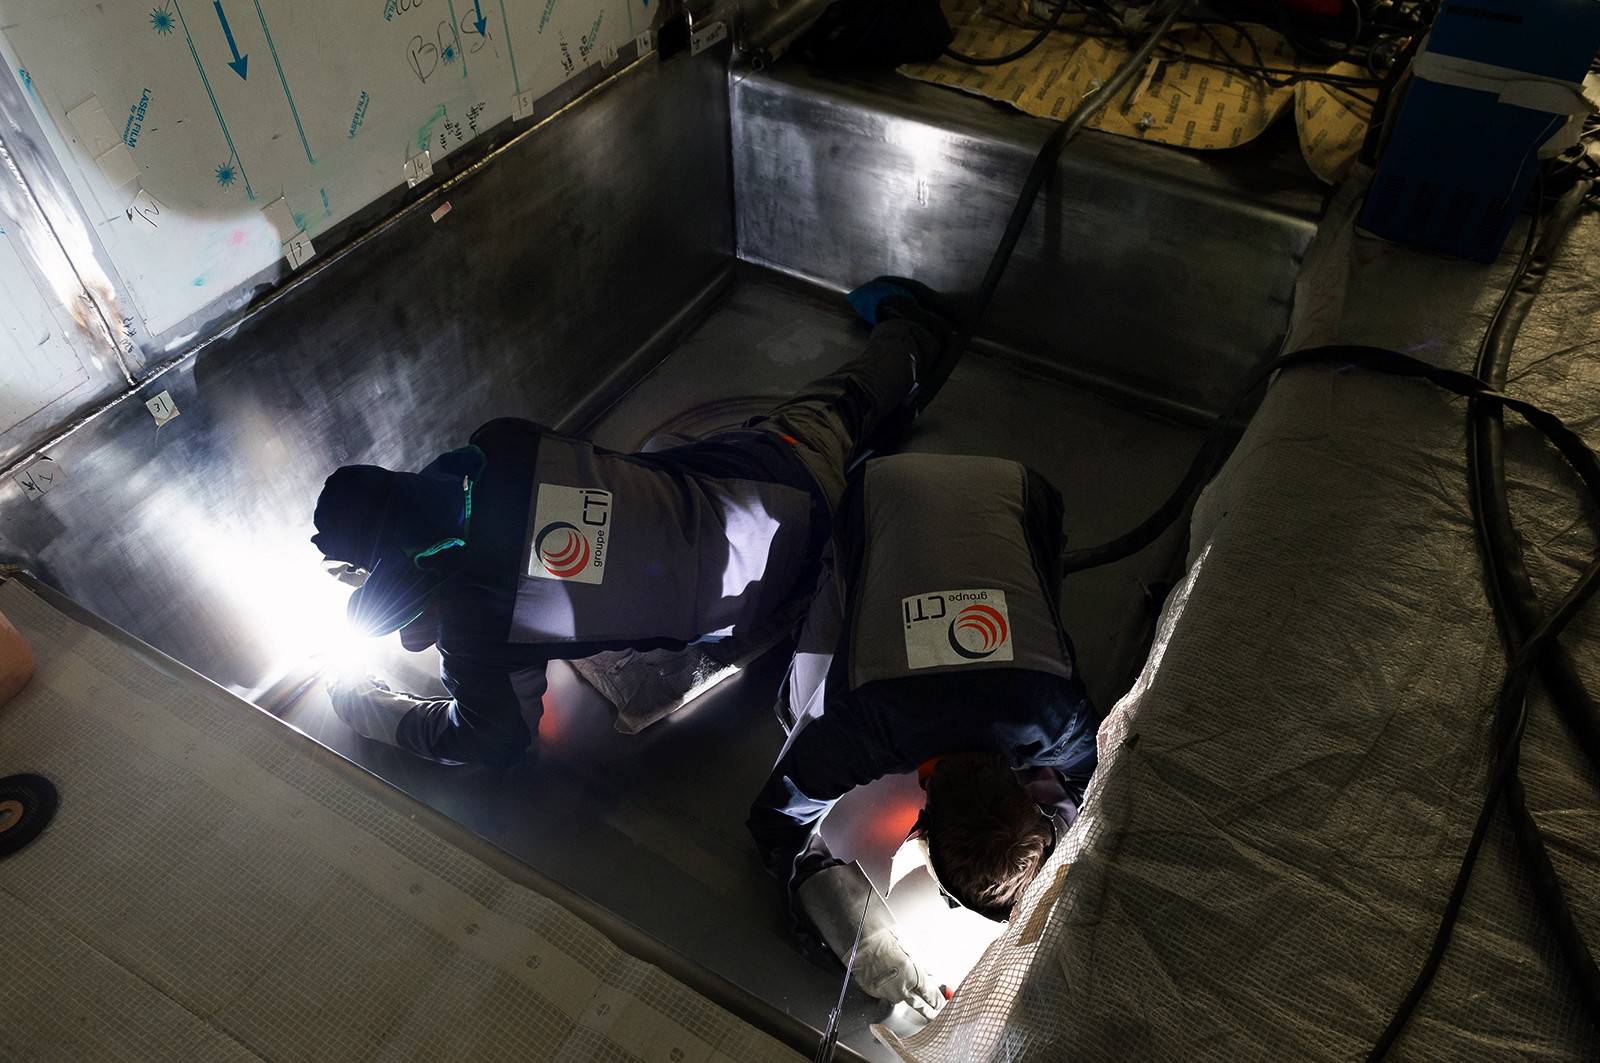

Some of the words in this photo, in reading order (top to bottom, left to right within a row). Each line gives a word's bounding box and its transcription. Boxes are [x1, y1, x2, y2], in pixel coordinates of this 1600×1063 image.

[130, 104, 137, 114] by
[135, 87, 152, 122] LASER
[127, 122, 141, 148] FILM
[579, 490, 609, 526] CTi
[594, 529, 606, 568] groupe
[904, 595, 946, 630] CTi
[948, 591, 988, 602] groupe
